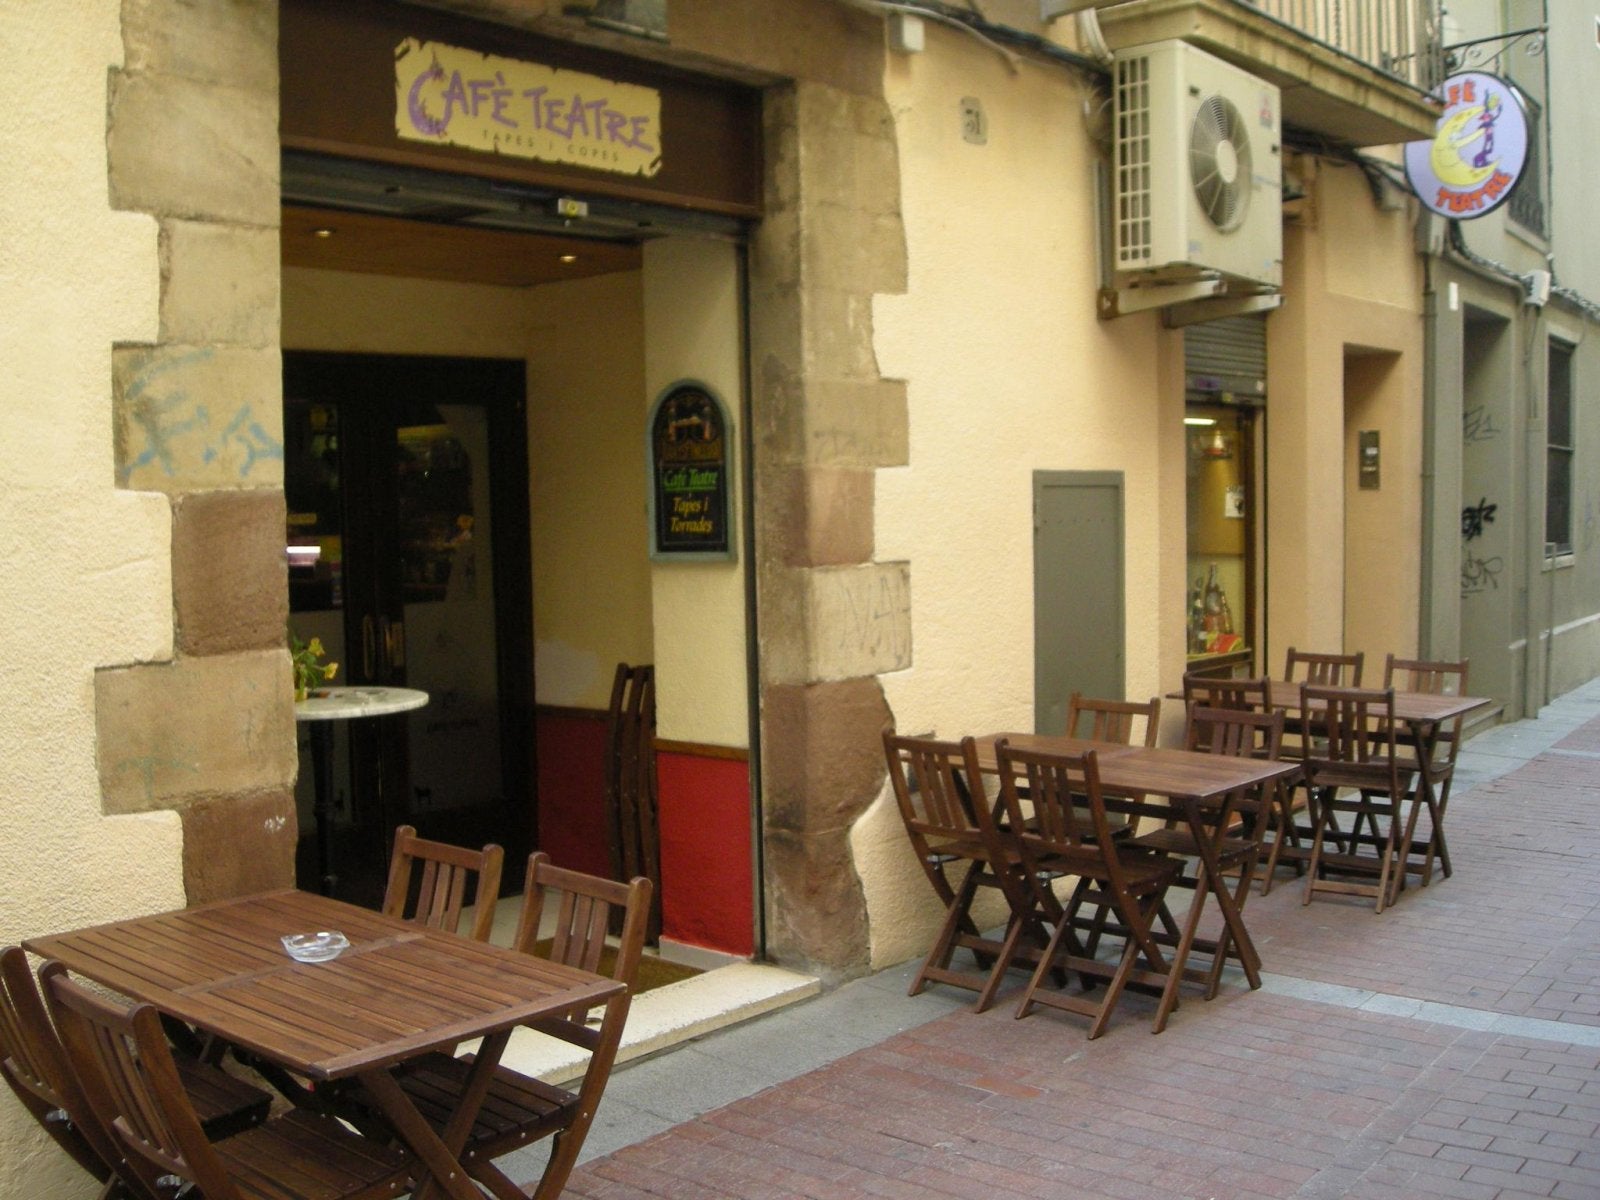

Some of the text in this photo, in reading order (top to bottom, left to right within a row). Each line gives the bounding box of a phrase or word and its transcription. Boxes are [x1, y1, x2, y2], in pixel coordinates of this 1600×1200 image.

[523, 86, 654, 152] TEATRE
[482, 129, 535, 147] TAPES
[567, 144, 619, 163] COPES
[673, 496, 701, 517] Tapes
